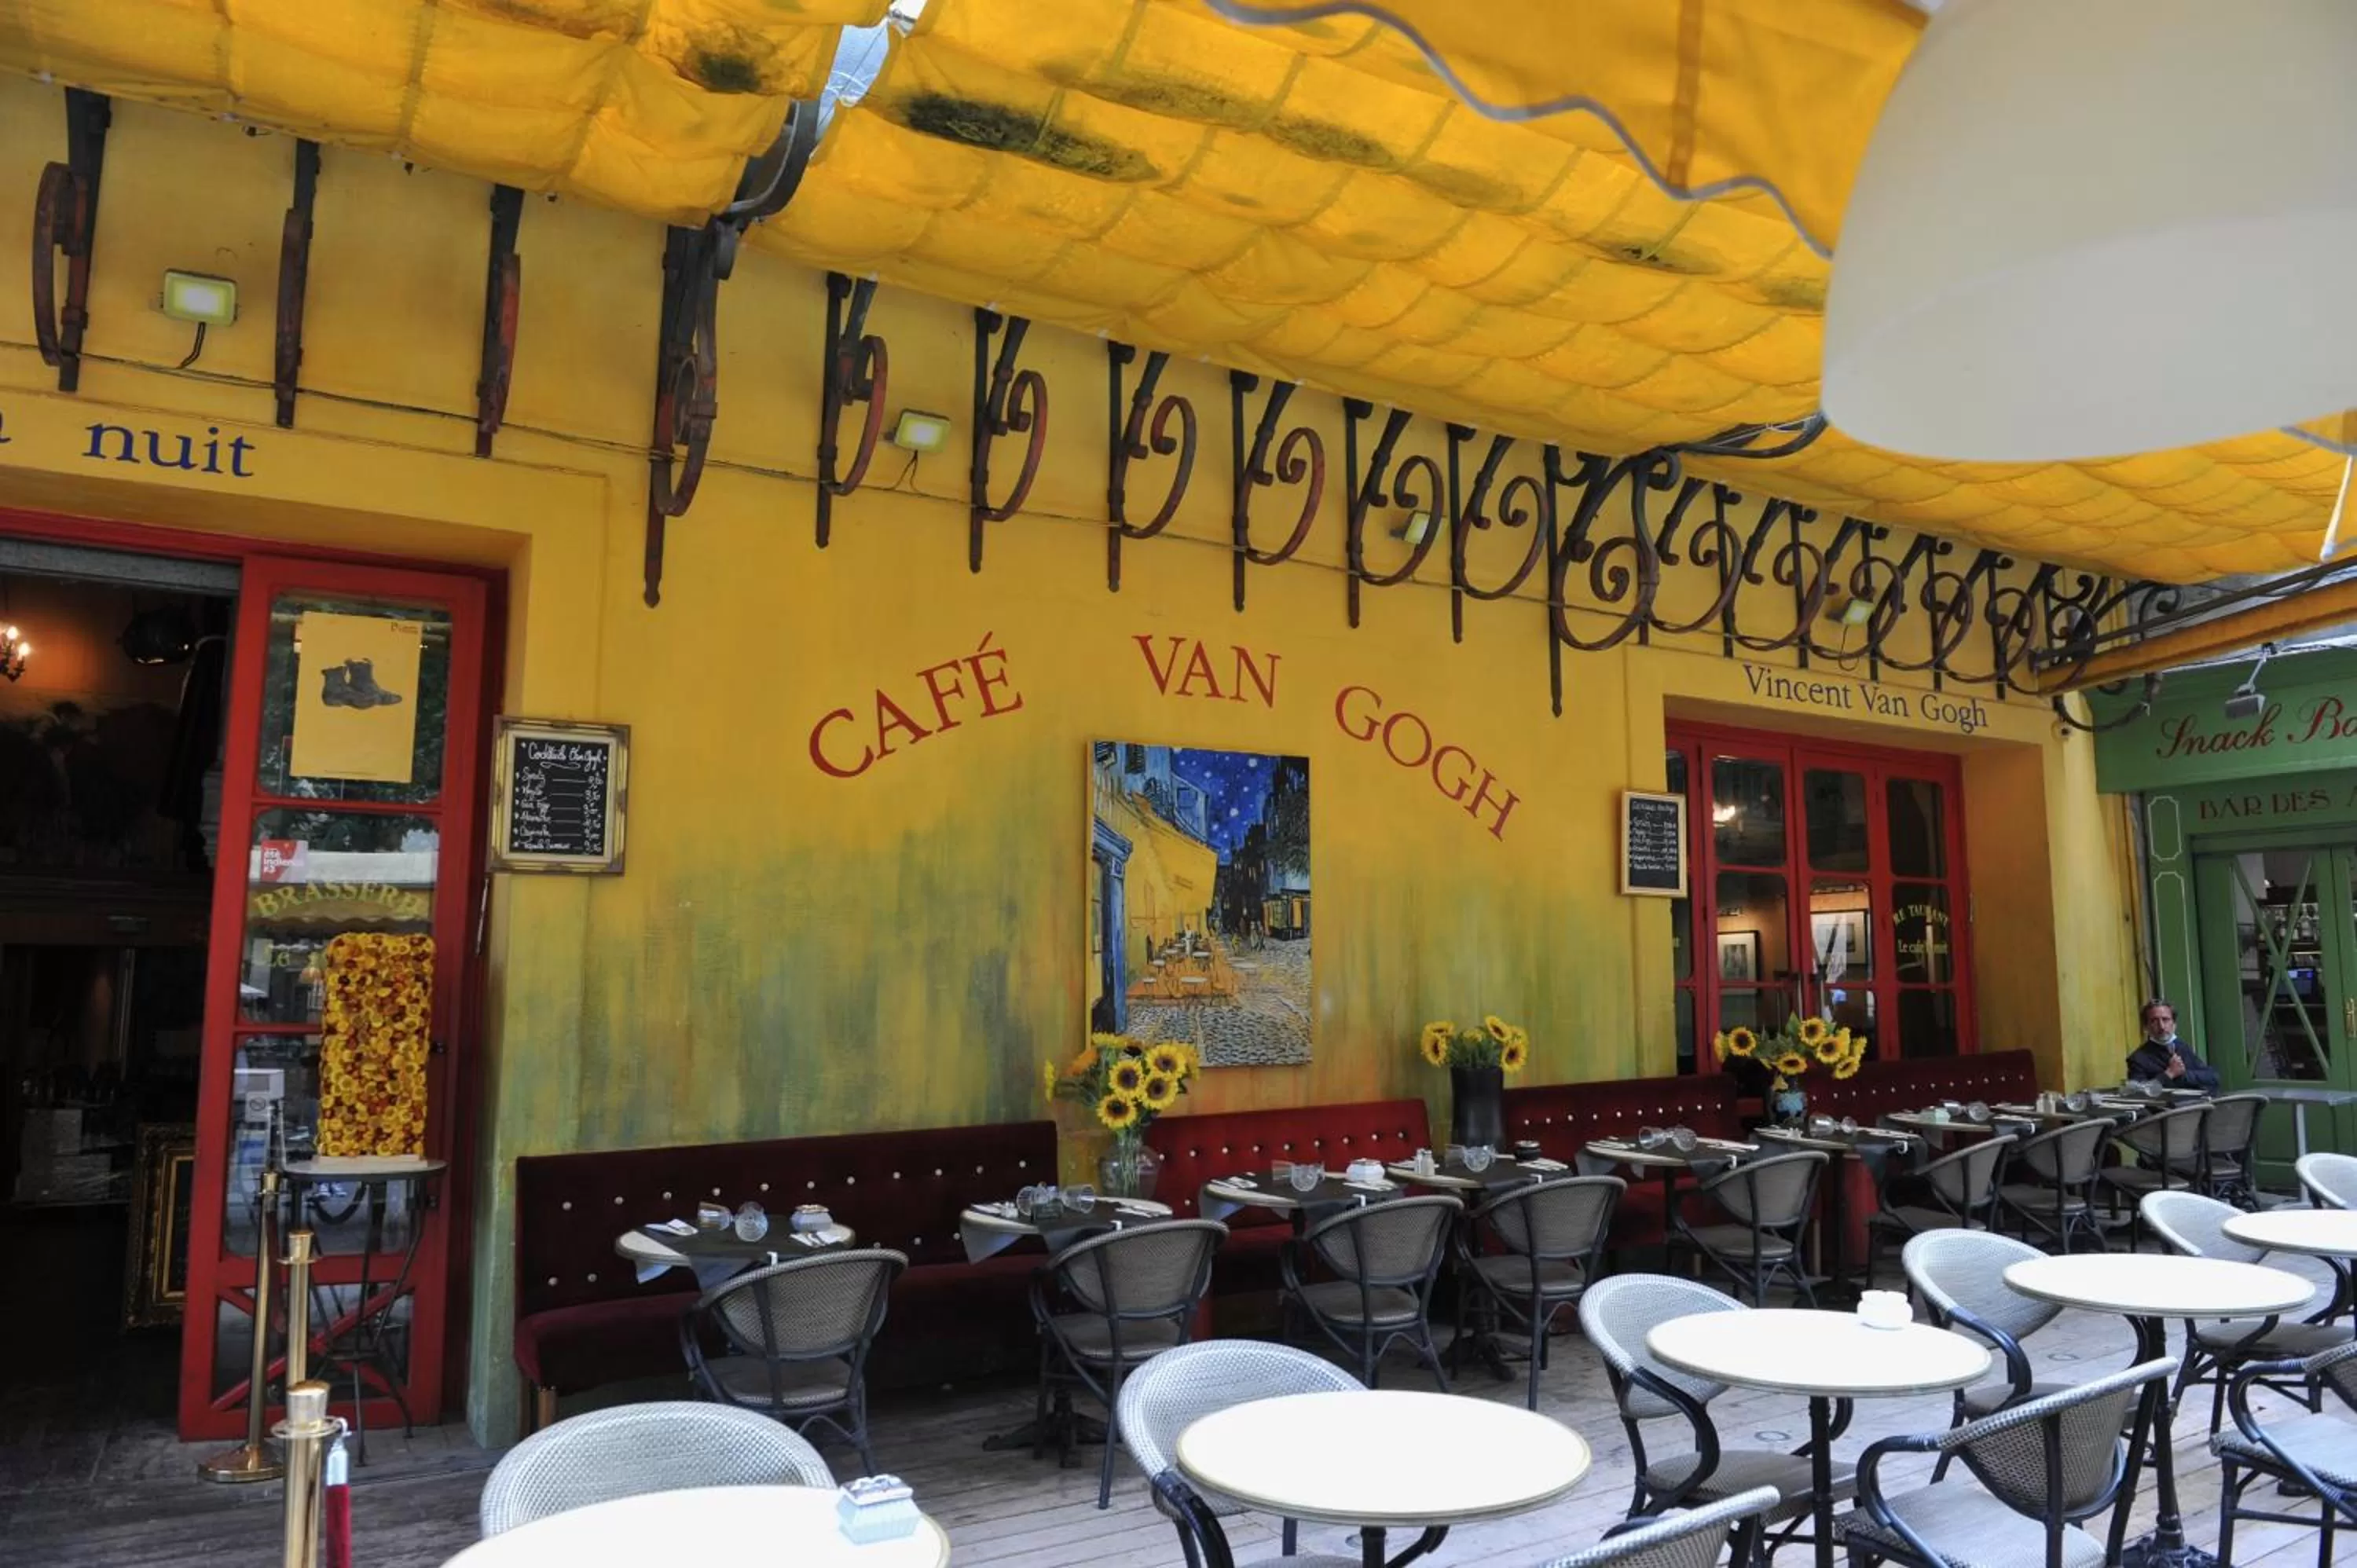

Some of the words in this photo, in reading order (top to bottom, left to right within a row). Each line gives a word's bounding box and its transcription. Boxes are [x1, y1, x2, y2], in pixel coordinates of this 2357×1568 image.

[82, 423, 256, 477] nuit
[1743, 665, 1852, 709] Vincent
[1860, 684, 1909, 717] Van
[1920, 694, 1989, 734] Gogh
[808, 631, 1025, 779] CAFÉ
[1132, 635, 1282, 709] VAN
[1334, 684, 1522, 842] GOGH
[2156, 703, 2283, 759] Snack
[2199, 794, 2263, 820] BAR
[2272, 789, 2332, 815] DES
